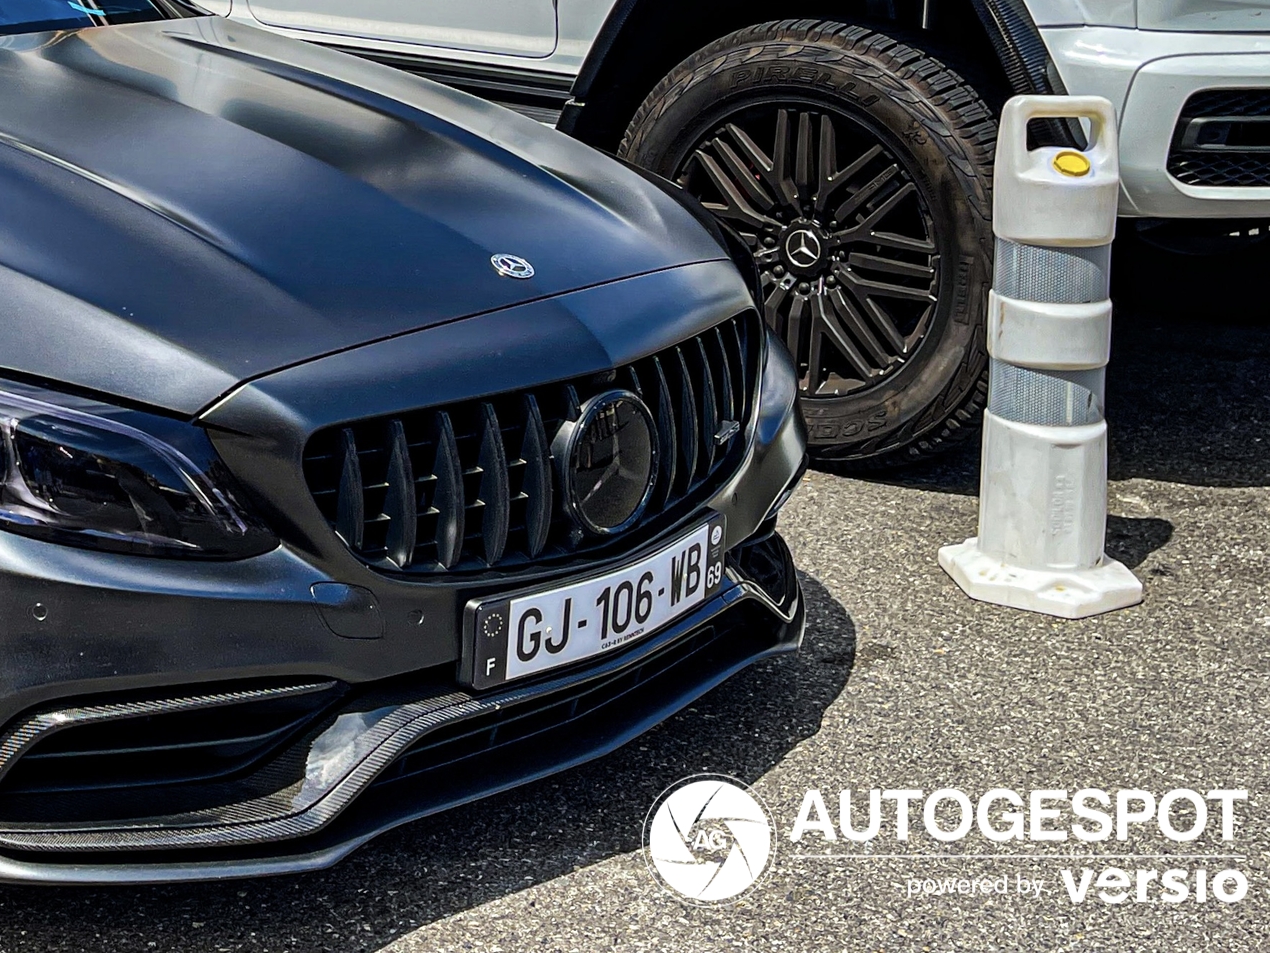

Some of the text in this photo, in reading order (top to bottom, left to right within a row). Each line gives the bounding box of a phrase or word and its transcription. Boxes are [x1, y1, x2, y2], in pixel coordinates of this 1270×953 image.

[729, 65, 881, 108] PIRELLI
[706, 560, 723, 589] 69
[486, 657, 496, 676] F
